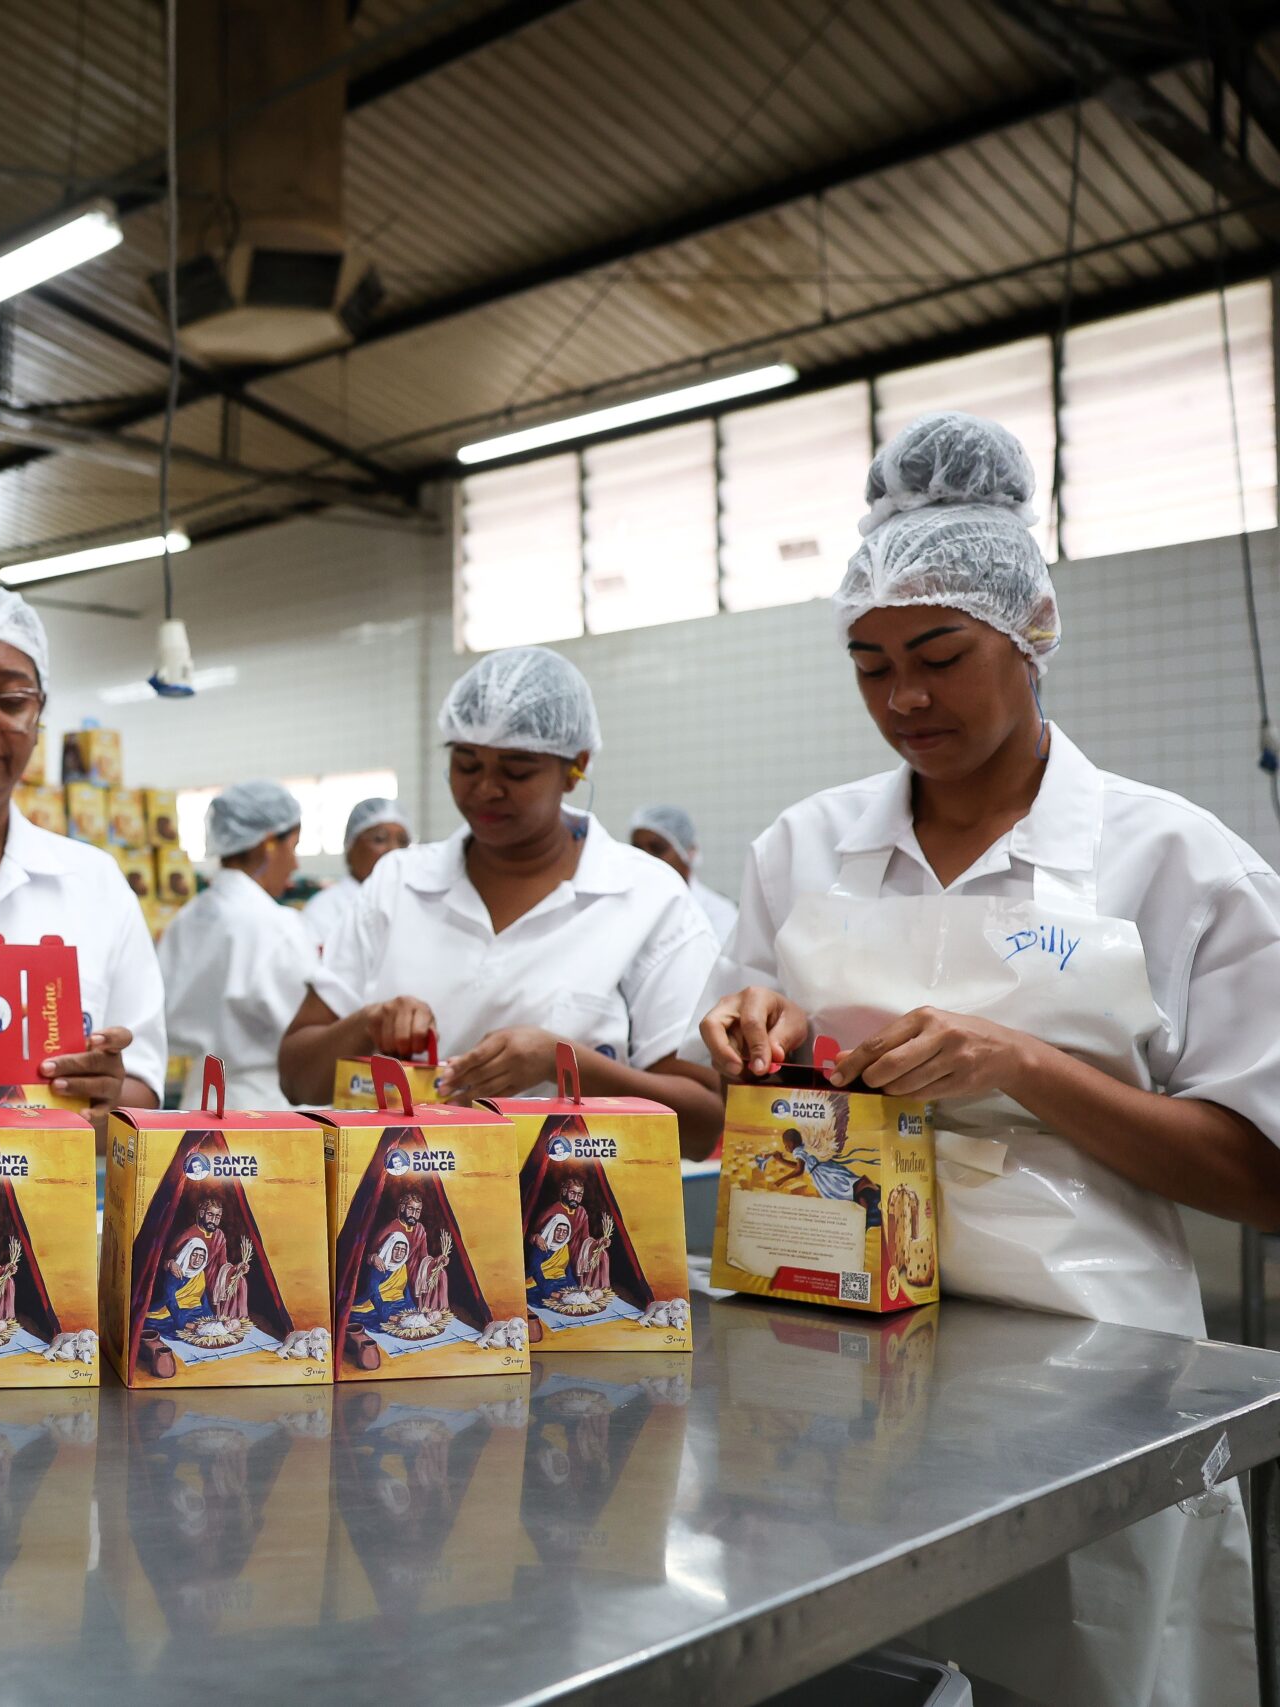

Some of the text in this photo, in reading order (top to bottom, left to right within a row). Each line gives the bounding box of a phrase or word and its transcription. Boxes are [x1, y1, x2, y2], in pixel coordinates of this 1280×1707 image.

[41, 982, 61, 1054] Panetone
[793, 1102, 826, 1111] SANTA
[792, 1110, 826, 1119] DULCE
[574, 1138, 617, 1148] SANTA
[412, 1150, 455, 1160] SANTA
[574, 1148, 617, 1158] DULCE
[213, 1156, 258, 1166] SANTA
[412, 1161, 456, 1171] DULCE
[213, 1166, 258, 1177] DULCE
